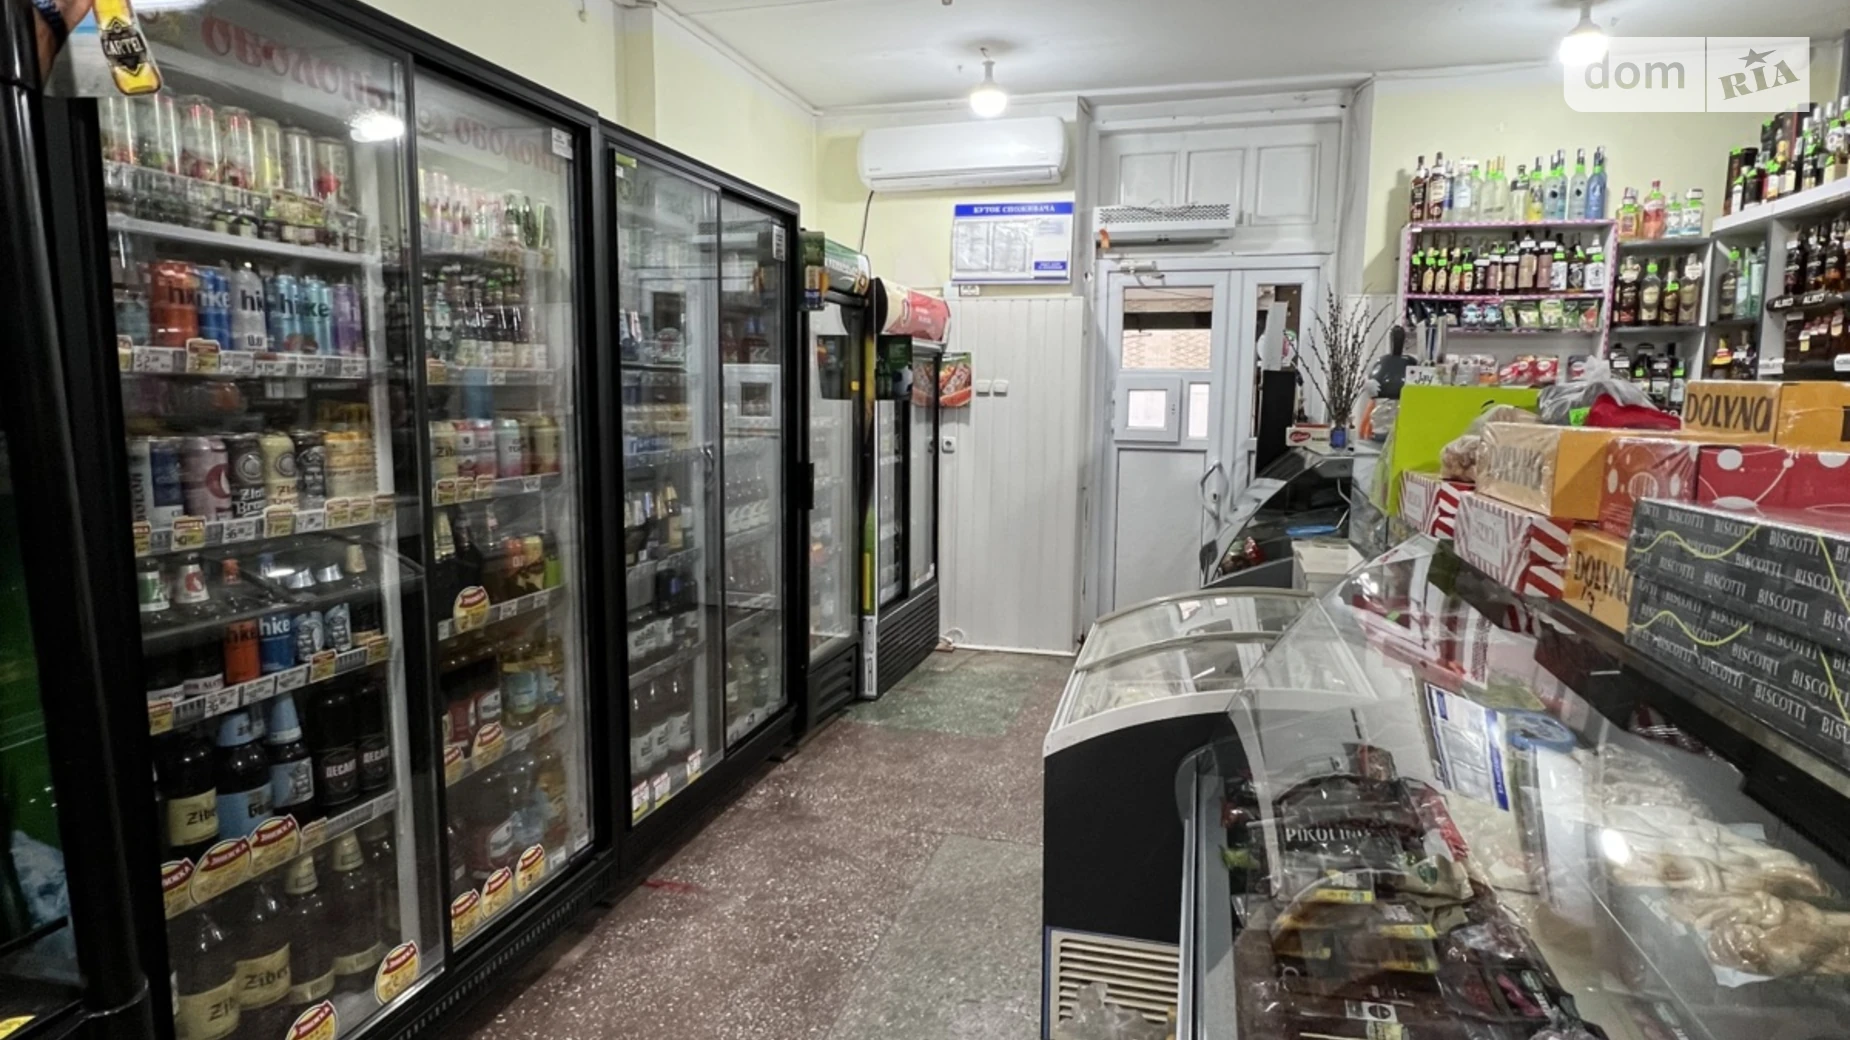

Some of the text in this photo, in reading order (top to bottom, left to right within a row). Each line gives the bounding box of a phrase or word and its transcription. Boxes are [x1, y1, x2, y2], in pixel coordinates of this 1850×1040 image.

[974, 206, 1000, 214] КУТОК
[1769, 530, 1820, 556] BISCOTTI
[1757, 588, 1809, 620] BISCOTTI
[260, 614, 291, 636] hike
[1754, 684, 1806, 722] BISCOTTI
